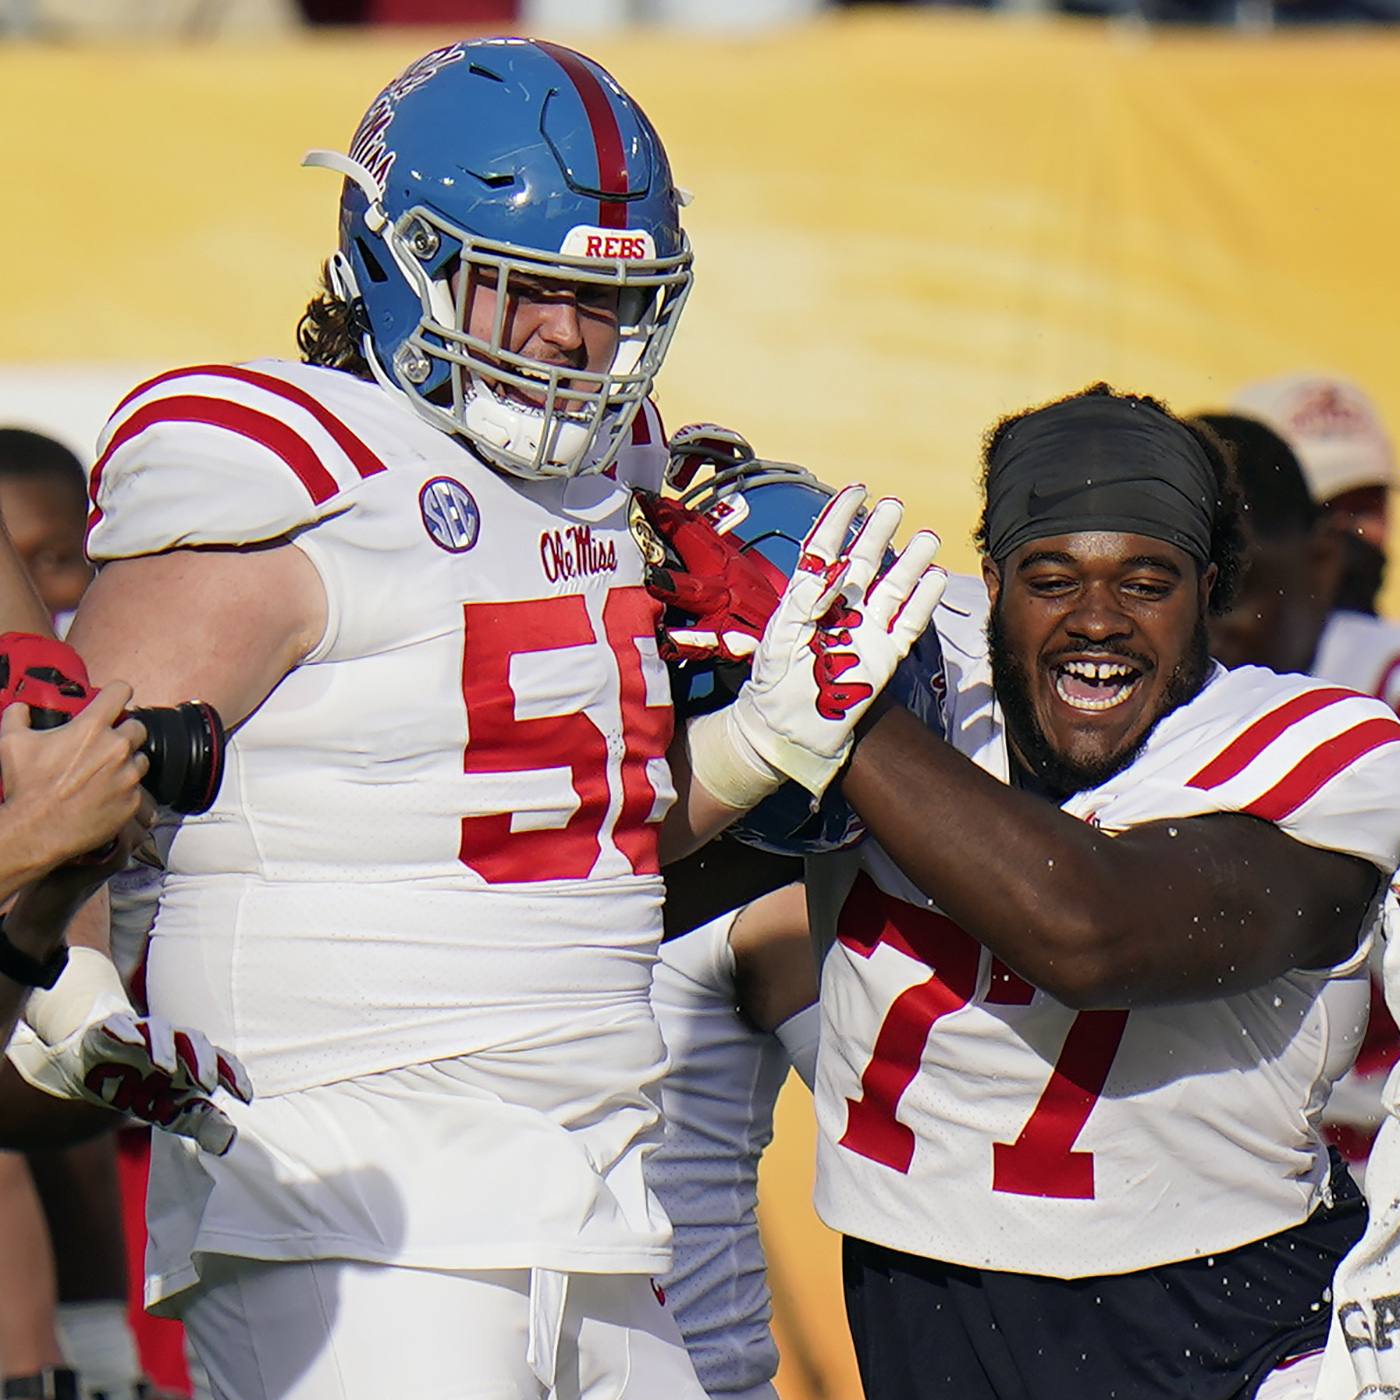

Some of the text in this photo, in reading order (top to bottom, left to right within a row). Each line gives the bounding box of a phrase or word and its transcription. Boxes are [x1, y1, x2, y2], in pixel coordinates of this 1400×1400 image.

[585, 235, 646, 260] REBS
[540, 529, 577, 583] Ole
[566, 525, 619, 579] Miss
[836, 868, 1096, 1200] 77
